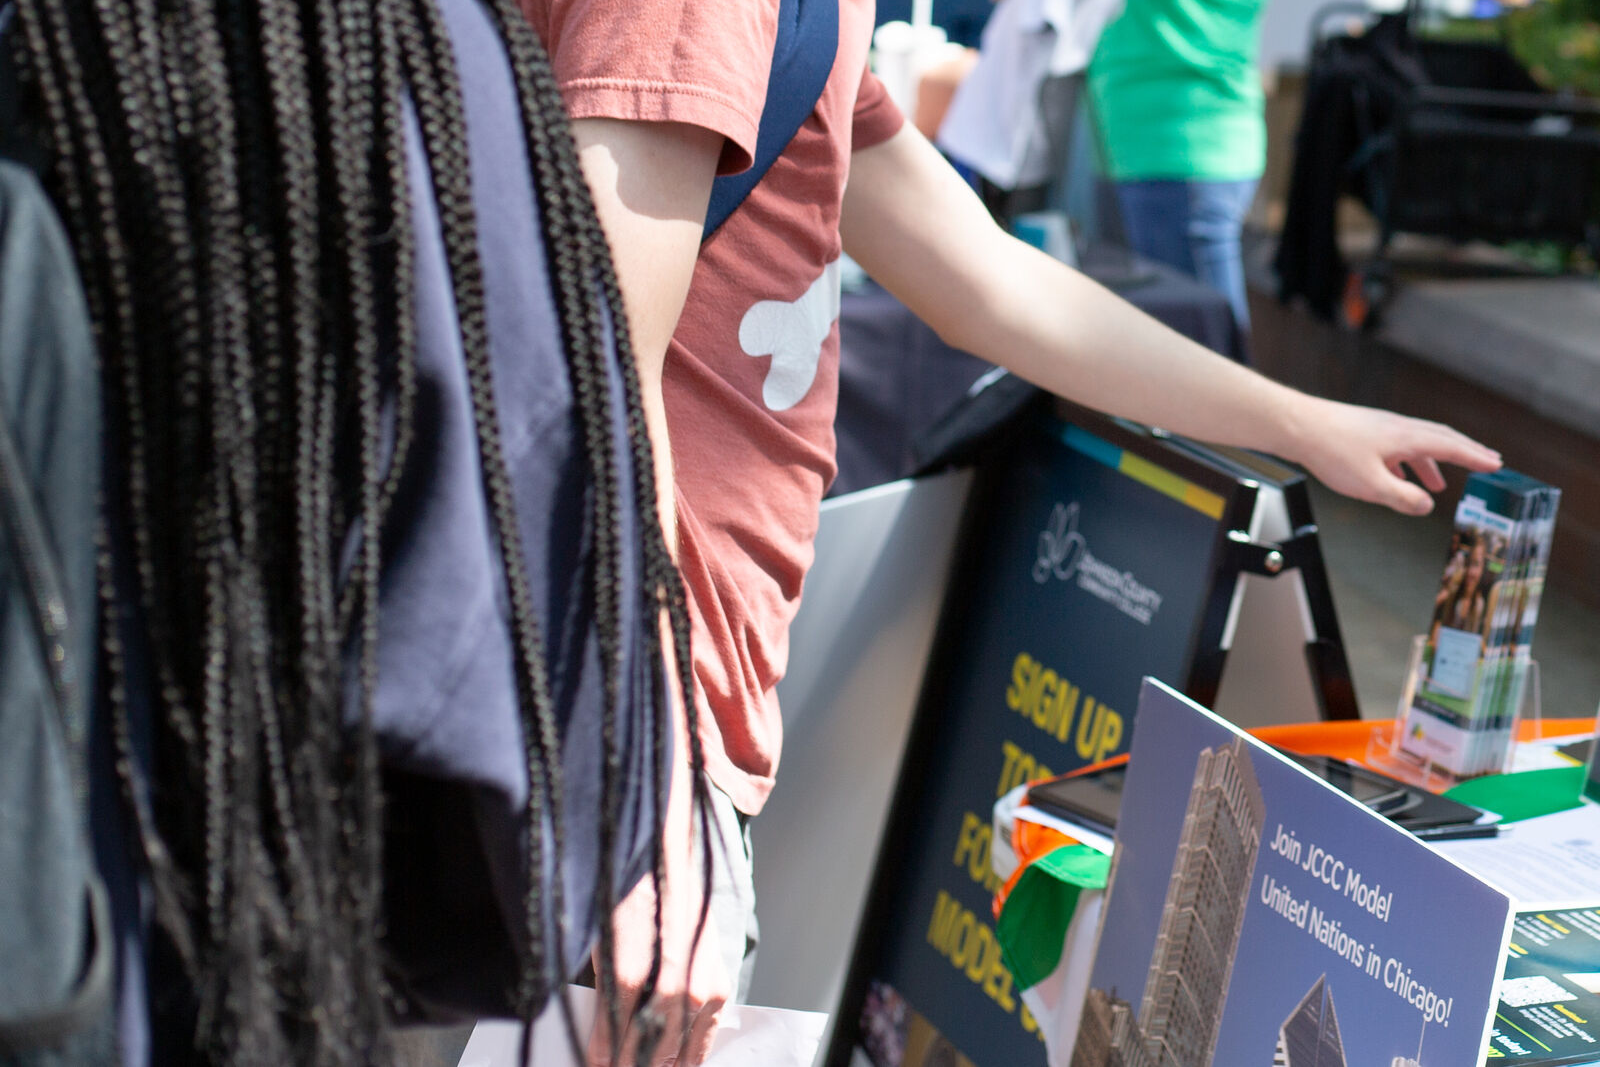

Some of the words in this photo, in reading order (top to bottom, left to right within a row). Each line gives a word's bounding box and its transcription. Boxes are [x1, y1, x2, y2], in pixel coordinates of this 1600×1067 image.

[1007, 651, 1079, 743] SIGN
[1075, 695, 1123, 763] UP
[1270, 823, 1302, 865] Join
[1302, 844, 1344, 891] JCCC
[1344, 868, 1393, 923] Model
[1261, 874, 1310, 929] United
[1308, 906, 1365, 968] Nations
[1365, 943, 1381, 980] in
[1384, 957, 1453, 1028] Chicago!
